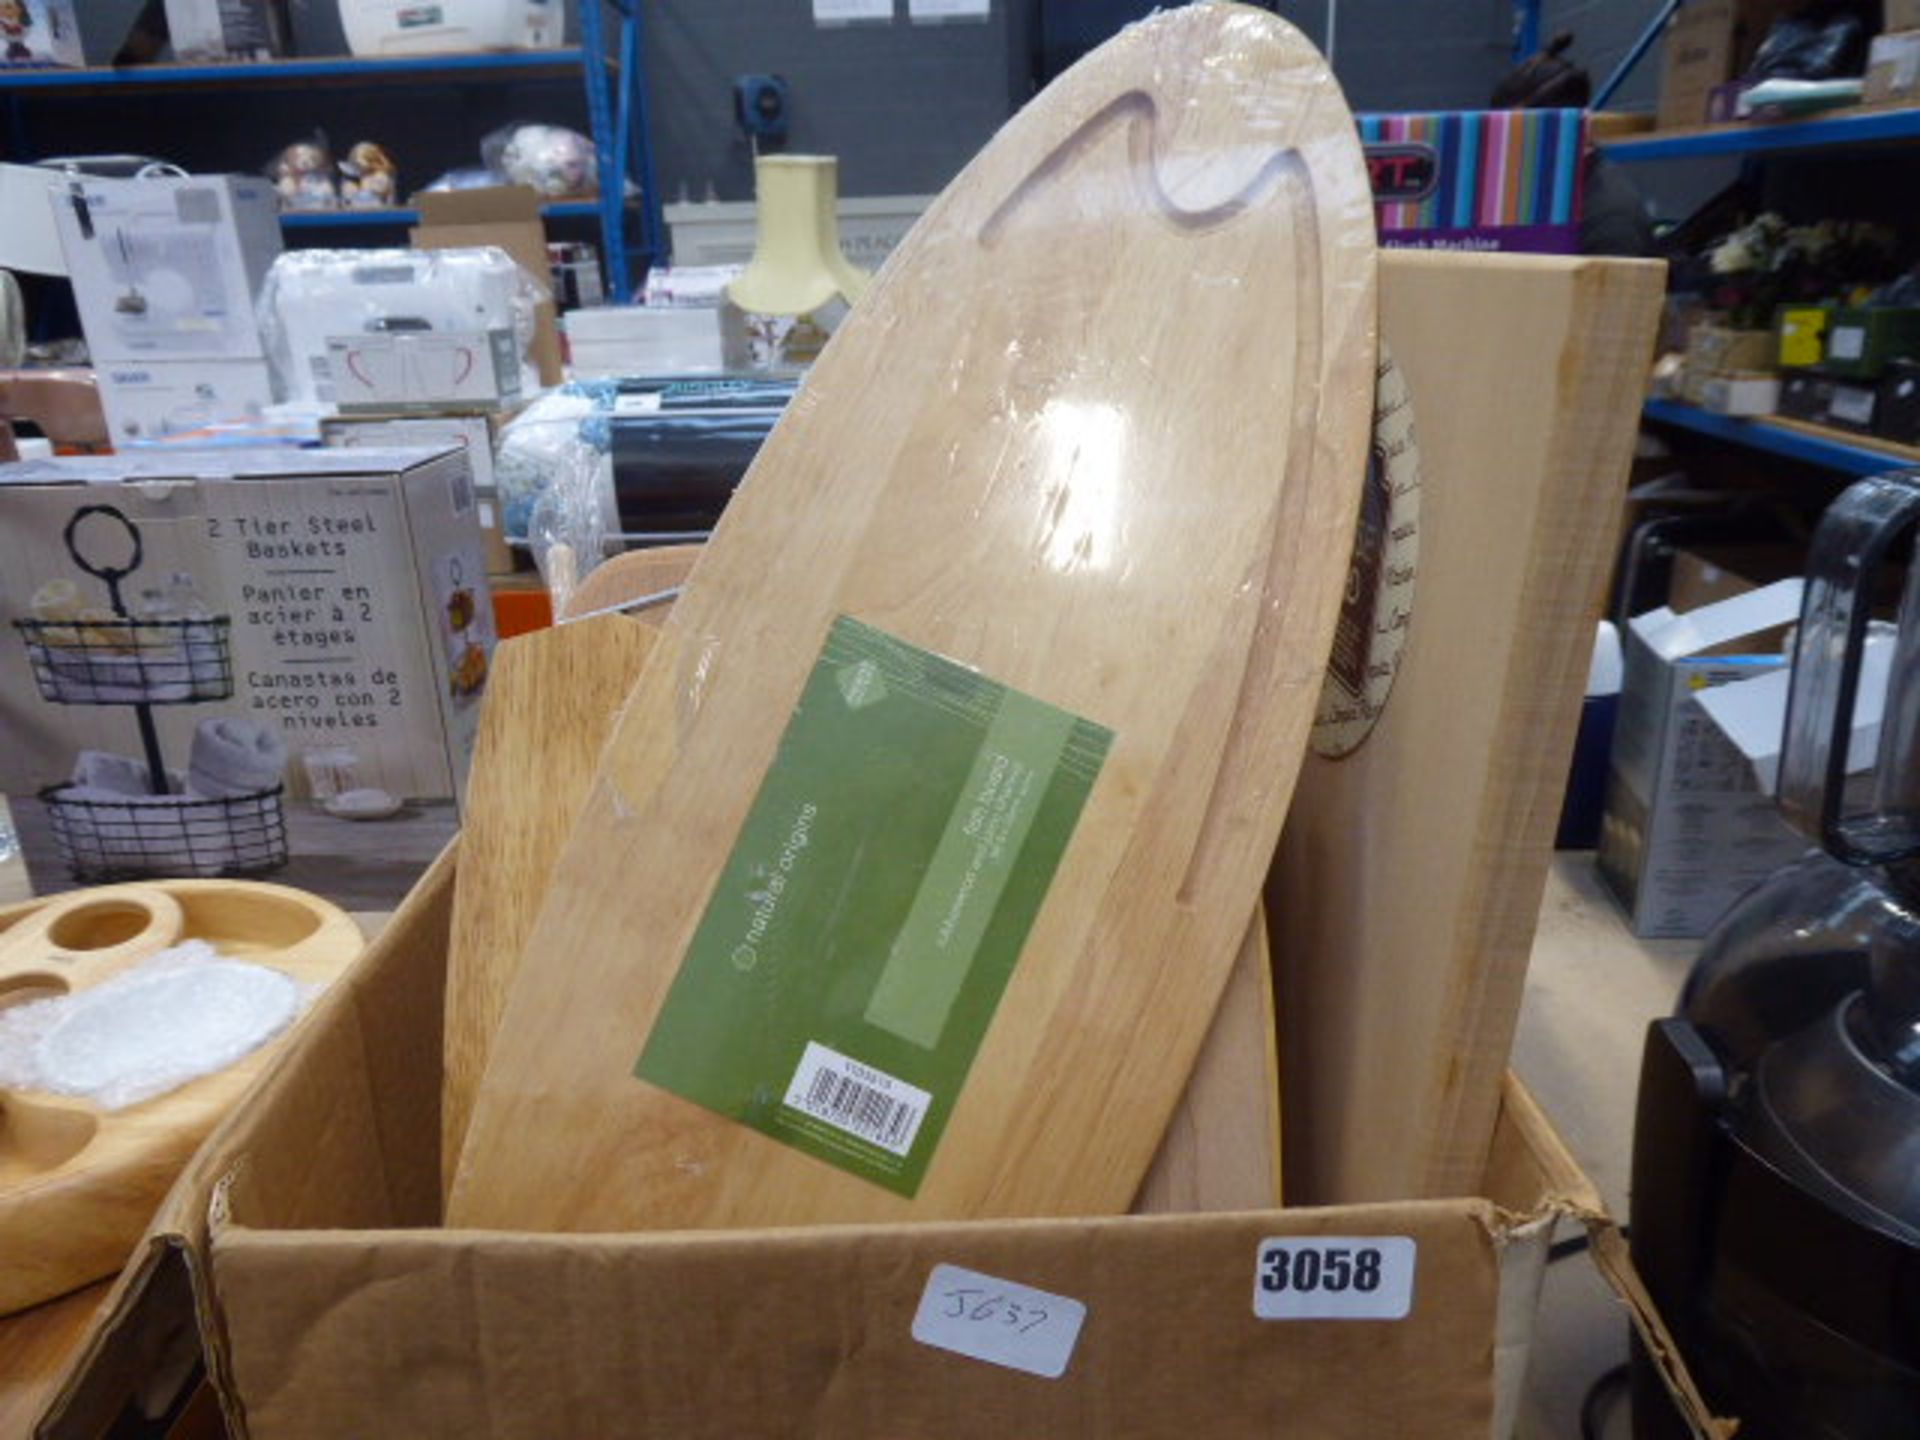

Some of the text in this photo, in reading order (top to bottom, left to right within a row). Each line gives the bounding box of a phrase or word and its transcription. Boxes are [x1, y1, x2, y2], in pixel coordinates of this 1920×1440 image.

[207, 509, 376, 538] 2 Tier Steel
[247, 539, 347, 559] Baskets
[242, 583, 370, 603] Panier en
[248, 605, 315, 625] acier
[359, 602, 373, 622] 2
[247, 667, 398, 688] Canastas de
[252, 687, 402, 709] acero con 2
[283, 710, 378, 730] niveles
[1262, 1247, 1382, 1293] 3058
